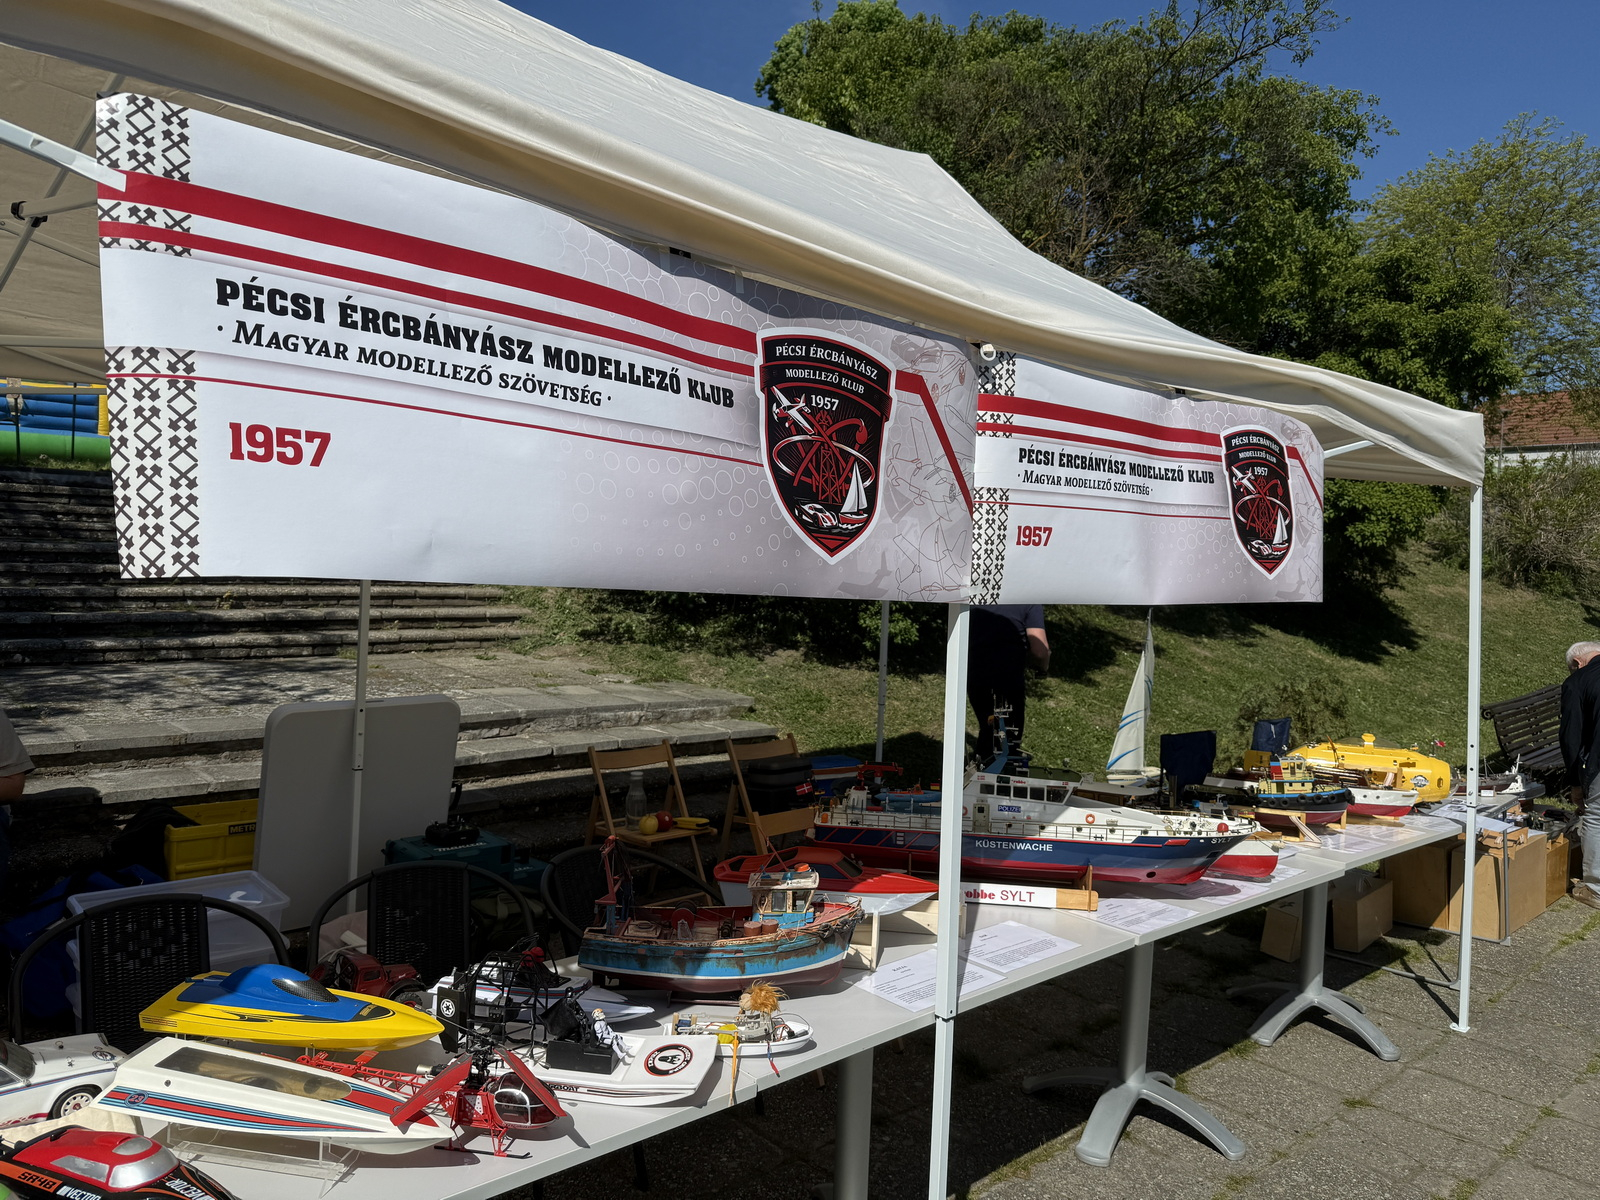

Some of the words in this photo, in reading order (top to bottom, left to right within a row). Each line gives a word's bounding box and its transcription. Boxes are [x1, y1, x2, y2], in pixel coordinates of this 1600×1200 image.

[216, 276, 325, 324] PÉCSI
[338, 295, 533, 364] ÉRCBÁNYÁSZ
[542, 344, 681, 395] MODELLEZŐ
[687, 378, 734, 408] KLUB
[232, 320, 349, 361] MAGYAR
[356, 346, 493, 386] MODELLEZŐ
[498, 372, 602, 407] SZÖVETSÉG
[775, 342, 806, 357] PÉCSI
[809, 344, 878, 380] ÉRCBÁNYÁSZ
[785, 368, 839, 383] MODELLEZŐ
[841, 377, 865, 394] KLUB
[810, 394, 839, 411] 1957
[229, 422, 331, 467] 1957
[1018, 445, 1055, 467] PÉCSI
[1058, 448, 1126, 476] ÉRCBÁNYÁSZ
[1129, 462, 1184, 482] MODELLEZŐ
[1188, 470, 1215, 484] KLUB
[1253, 466, 1268, 476] 1957
[1022, 470, 1062, 486] MAGYAR
[1064, 476, 1112, 491] MODELLEZŐ
[1114, 479, 1150, 496] SZÖVETSÉG
[1015, 525, 1053, 547] 1957
[230, 824, 256, 834] METR
[1211, 837, 1232, 845] SYLT
[975, 839, 1053, 852] KÜSTENWACHE
[964, 889, 996, 900] obbe
[1000, 890, 1035, 902] SYLT
